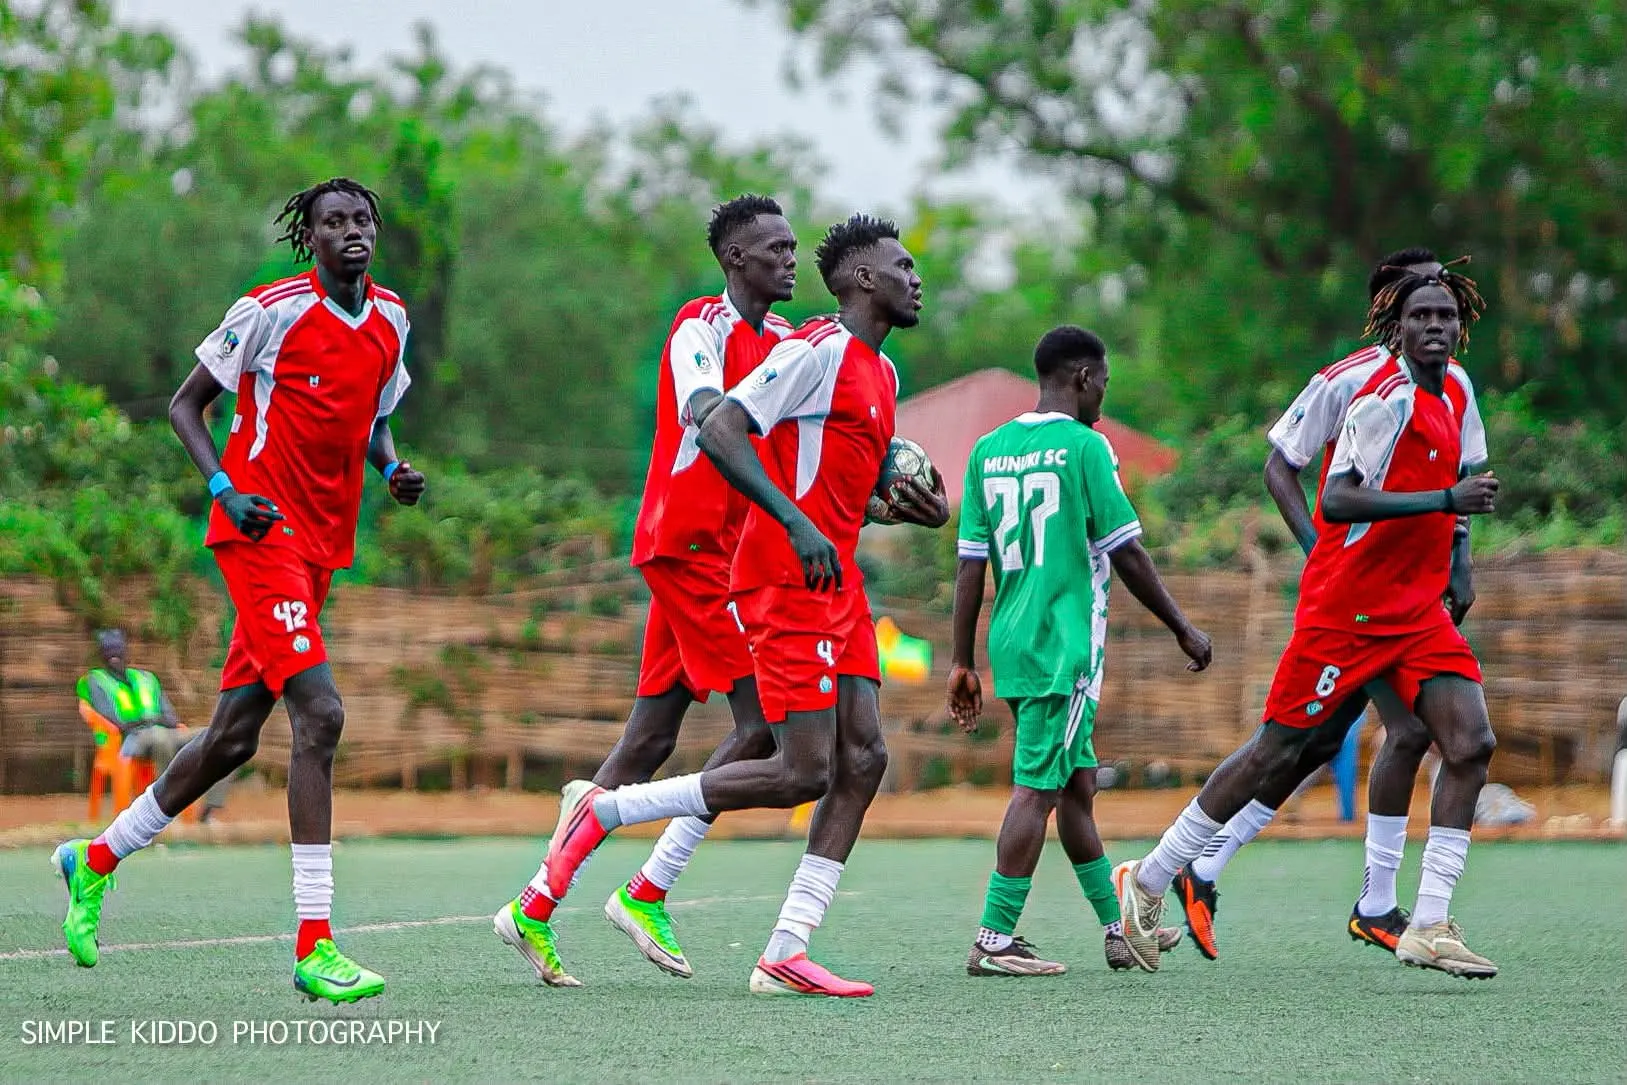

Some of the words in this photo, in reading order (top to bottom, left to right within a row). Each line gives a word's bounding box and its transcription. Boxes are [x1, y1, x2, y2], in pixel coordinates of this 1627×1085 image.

[1043, 448, 1068, 466] SC
[983, 471, 1060, 571] 27
[273, 600, 308, 632] 42
[816, 639, 835, 667] 4
[1315, 665, 1341, 697] 6
